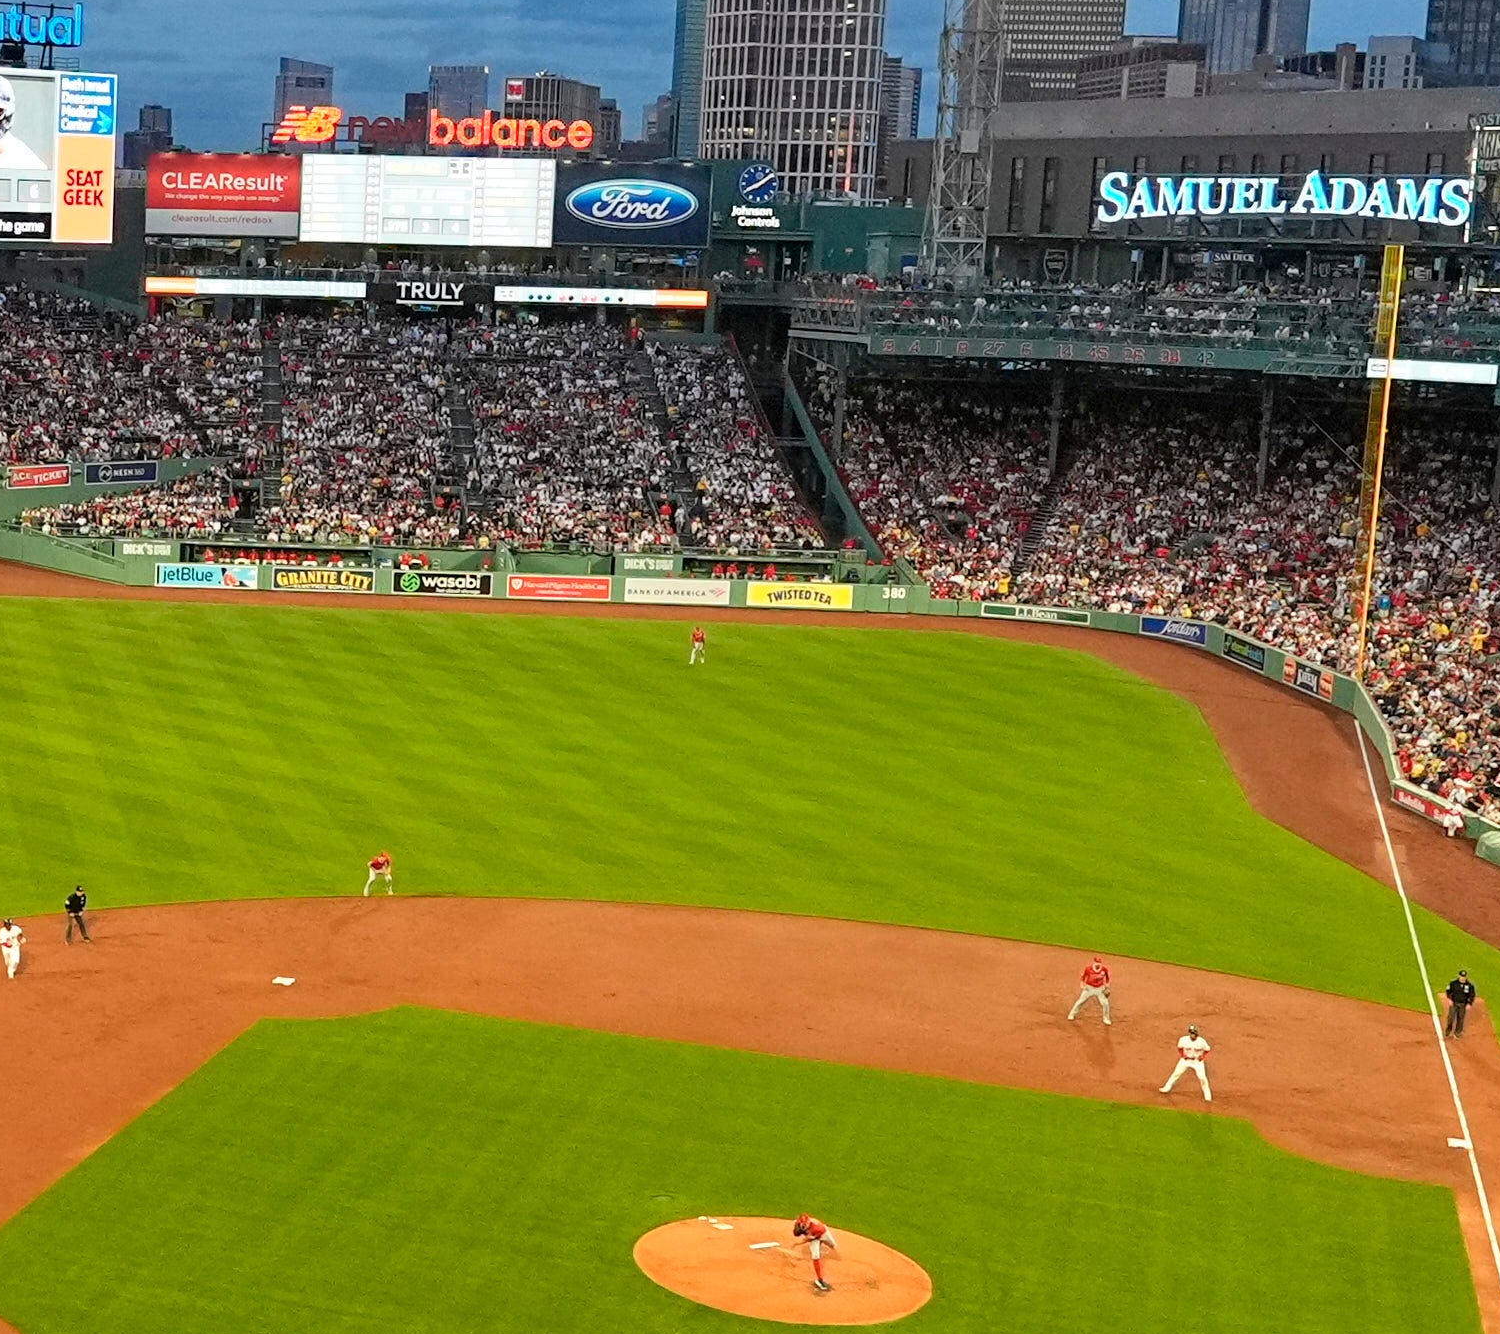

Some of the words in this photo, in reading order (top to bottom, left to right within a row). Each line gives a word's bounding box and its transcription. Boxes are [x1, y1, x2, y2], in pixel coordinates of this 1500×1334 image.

[430, 108, 595, 149] balance
[66, 168, 103, 187] SEAT
[161, 171, 284, 191] CLEAResult
[63, 189, 104, 207] GEEK
[593, 185, 668, 220] Ford
[1097, 171, 1289, 223] SAMUEL
[1295, 169, 1473, 227] ADAMS
[171, 213, 273, 225] clearesult.com/redsox
[731, 205, 774, 218] Johnson
[14, 221, 45, 235] game
[737, 215, 780, 229] Controls
[396, 282, 464, 301] TRULY
[10, 470, 33, 484] ACE
[32, 468, 69, 485] TICKET
[122, 543, 153, 556] DICK'S
[624, 558, 656, 571] DICK'S
[162, 566, 214, 585] jetBlue
[275, 570, 339, 589] GRANITE
[341, 572, 373, 591] CITY
[422, 574, 481, 589] wasabi
[627, 588, 653, 596] BANK
[653, 588, 666, 596] OF
[666, 588, 707, 597] AMERICA
[766, 586, 813, 604] TWISTED
[813, 589, 833, 605] TEA
[882, 586, 906, 600] 380
